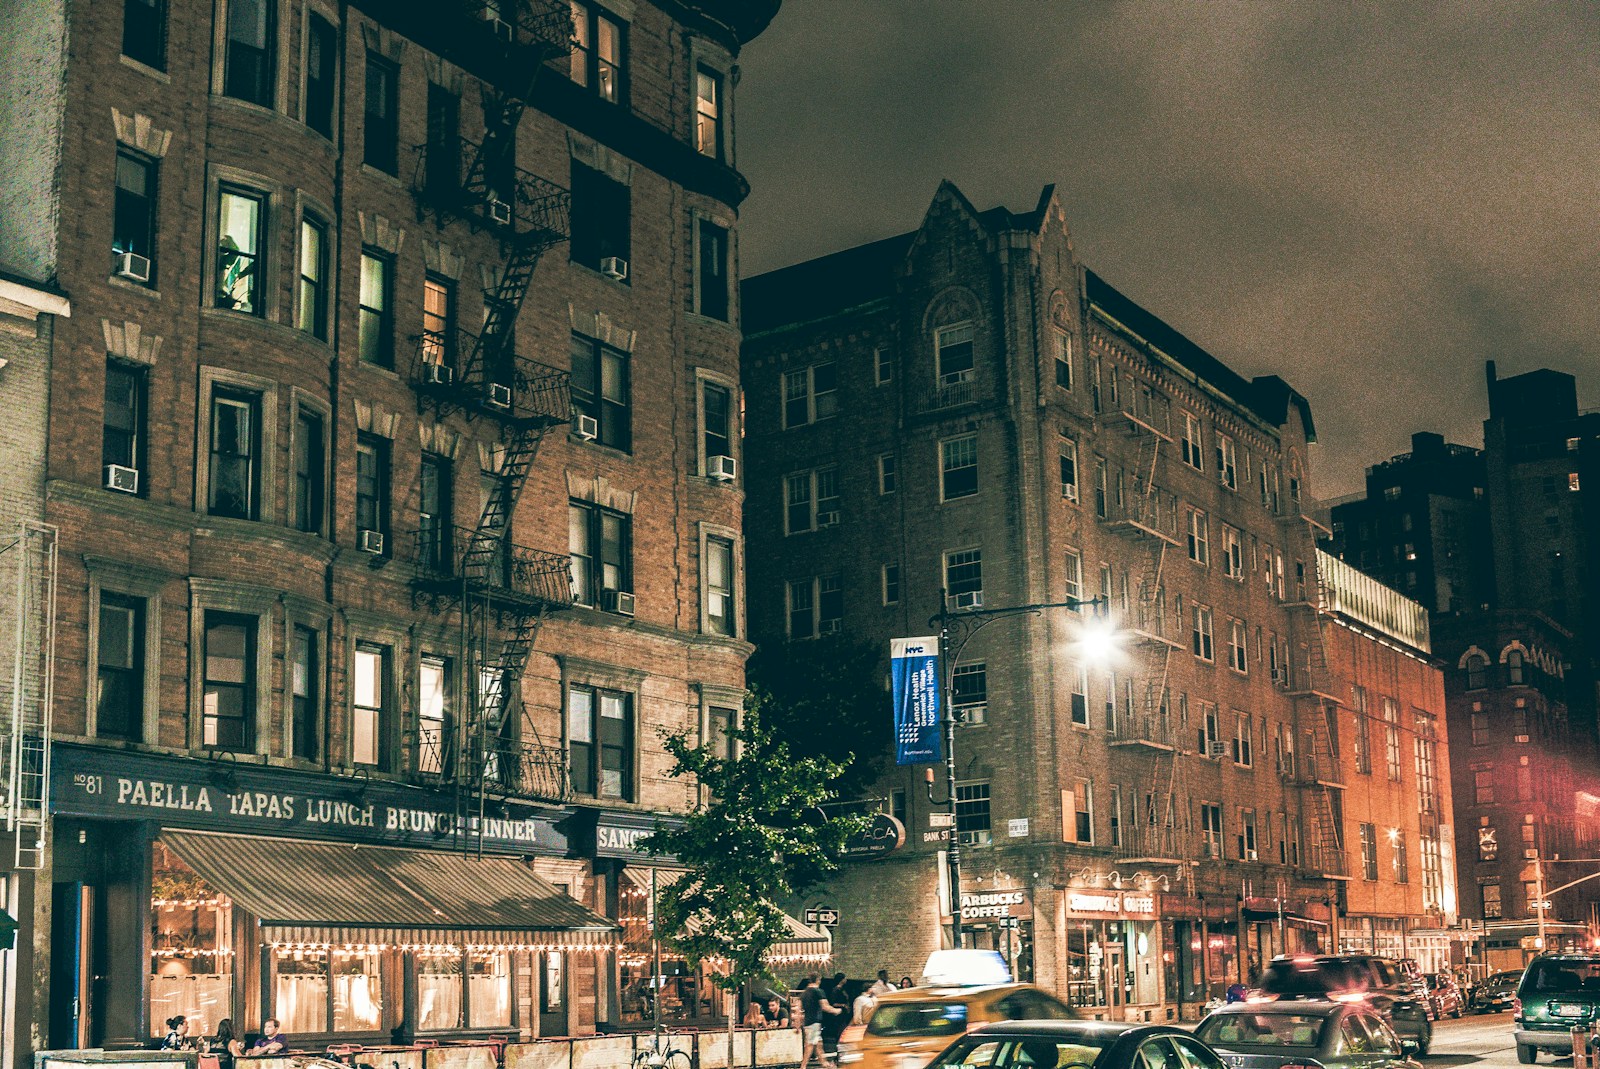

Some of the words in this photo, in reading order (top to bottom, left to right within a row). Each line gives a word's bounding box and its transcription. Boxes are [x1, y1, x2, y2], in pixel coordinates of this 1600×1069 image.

[905, 646, 924, 654] NYC
[925, 659, 934, 686] Health
[911, 671, 920, 700] Health
[913, 702, 921, 727] Lenox
[926, 687, 936, 727] Northwell
[86, 775, 102, 795] 81
[117, 779, 213, 813] PAELLA
[226, 792, 294, 820] TAPAS
[306, 799, 374, 827] LUNCH
[386, 807, 463, 836] BRUNCH
[862, 826, 896, 841] ACA
[923, 831, 940, 842] BANK
[941, 830, 950, 840] ST
[961, 892, 1024, 907] ARBUCKS
[1123, 896, 1154, 913] COFFEE
[961, 905, 1009, 918] COFFEE
